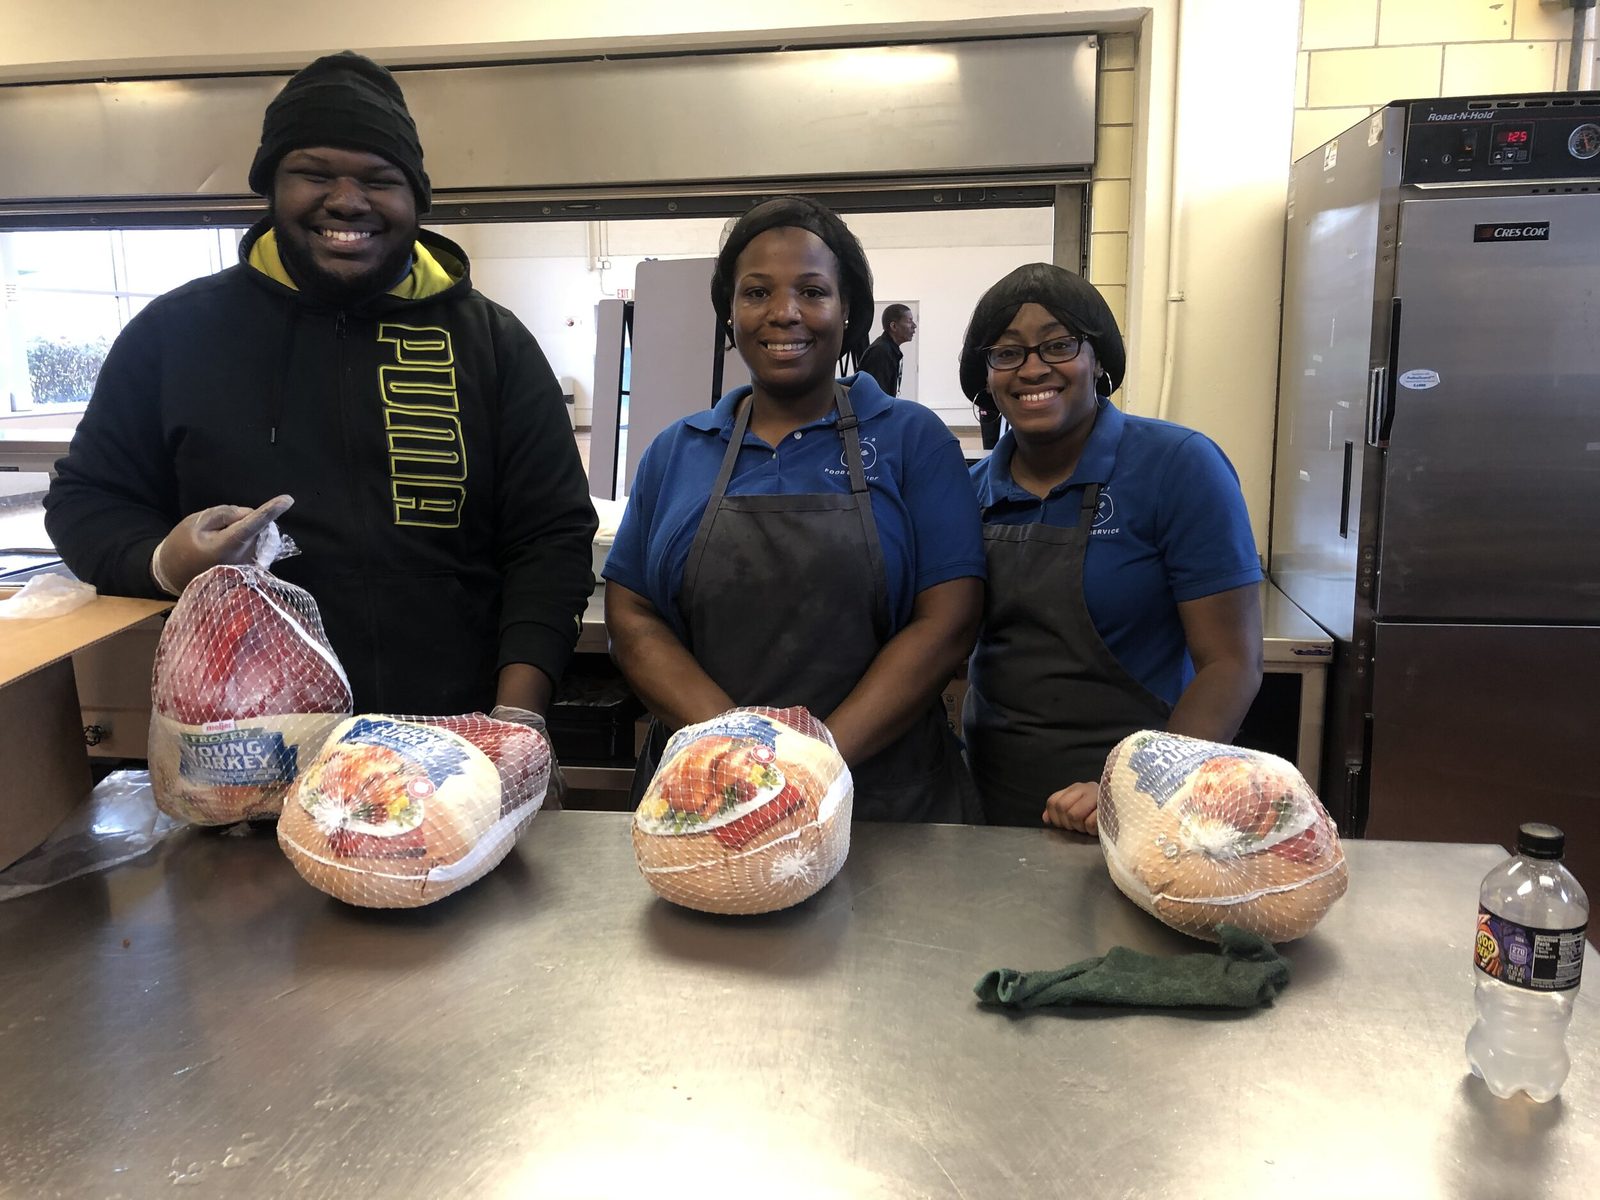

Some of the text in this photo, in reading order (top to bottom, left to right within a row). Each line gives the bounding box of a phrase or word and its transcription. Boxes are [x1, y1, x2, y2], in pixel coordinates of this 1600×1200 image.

[1428, 111, 1495, 121] Roast-N-Hold
[1494, 226, 1546, 237] CRES COR
[377, 323, 468, 528] PUMA
[190, 731, 249, 743] FROZEN
[185, 741, 262, 758] YOUNG
